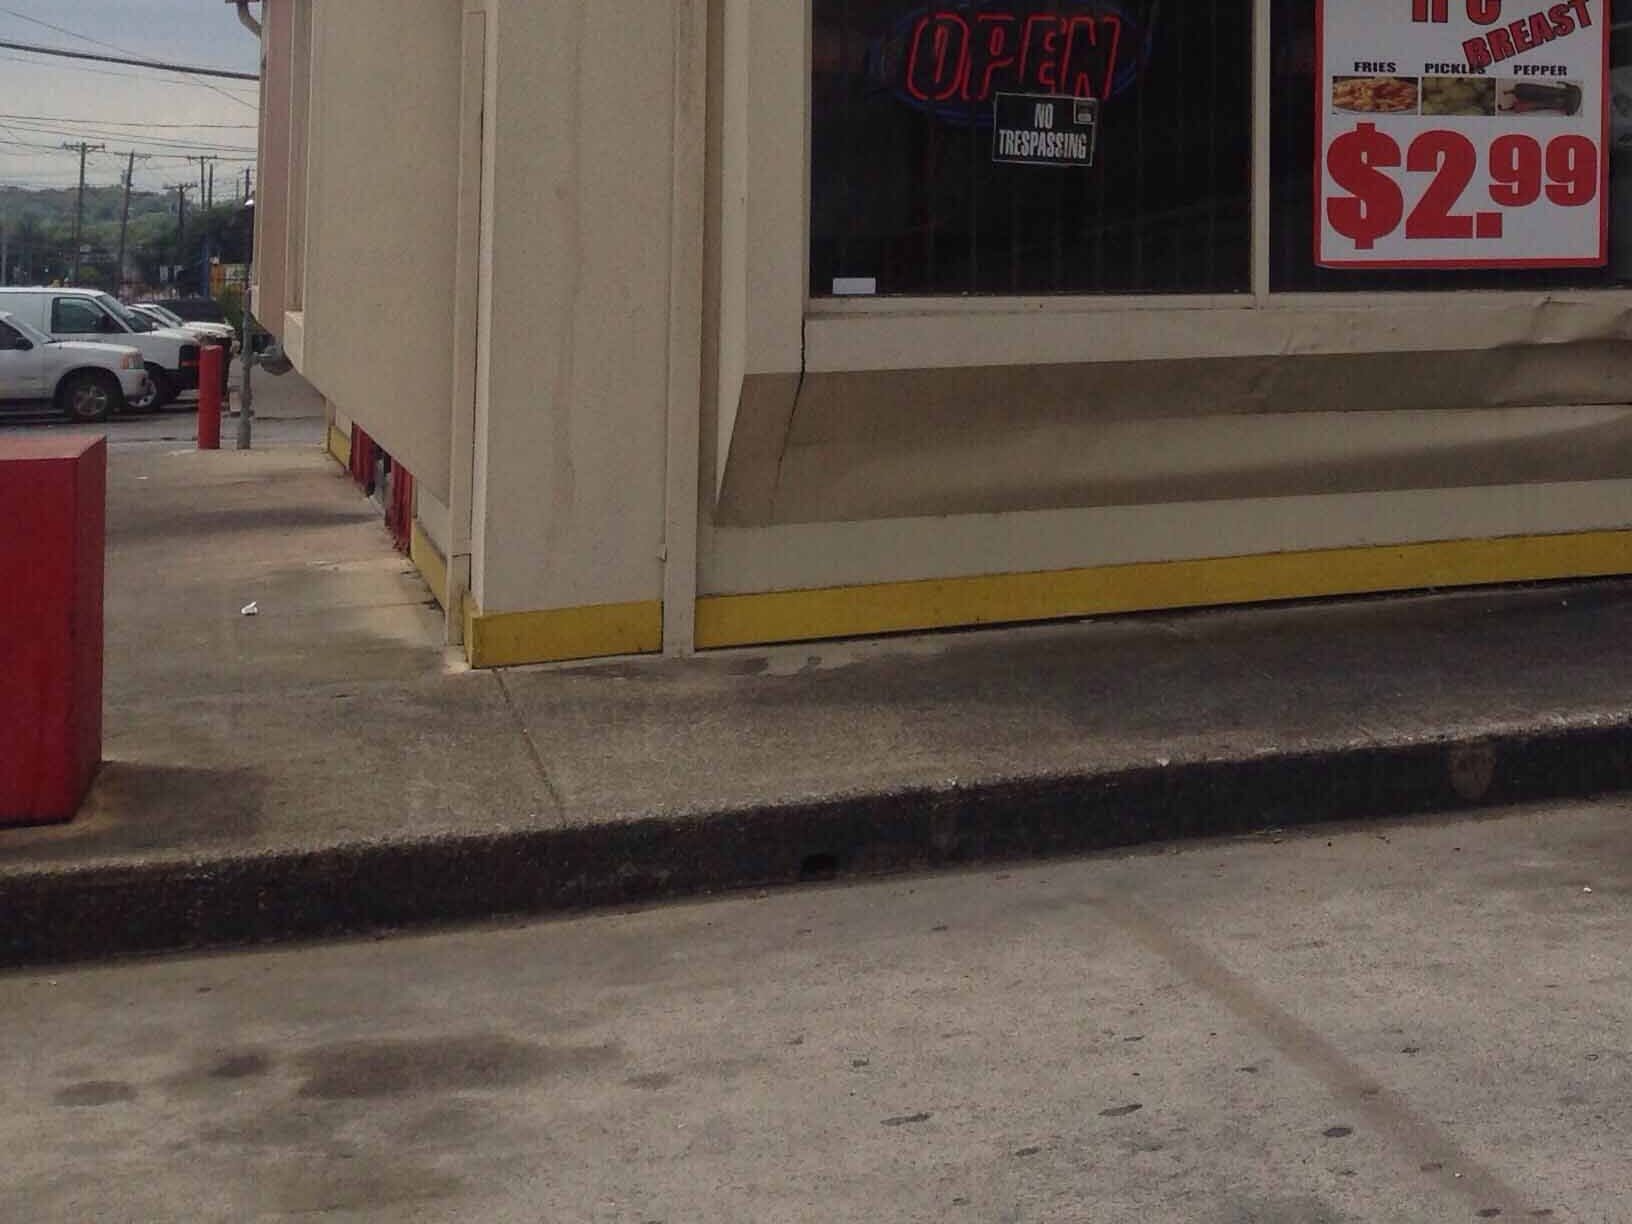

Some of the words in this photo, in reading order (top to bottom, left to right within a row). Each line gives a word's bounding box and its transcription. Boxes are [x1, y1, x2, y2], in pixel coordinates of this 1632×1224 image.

[906, 10, 1121, 102] OPEN
[1354, 61, 1397, 73] FRIES
[1514, 64, 1568, 76] PEPPER
[1034, 103, 1054, 130] NO
[999, 129, 1087, 159] TRESPASSING
